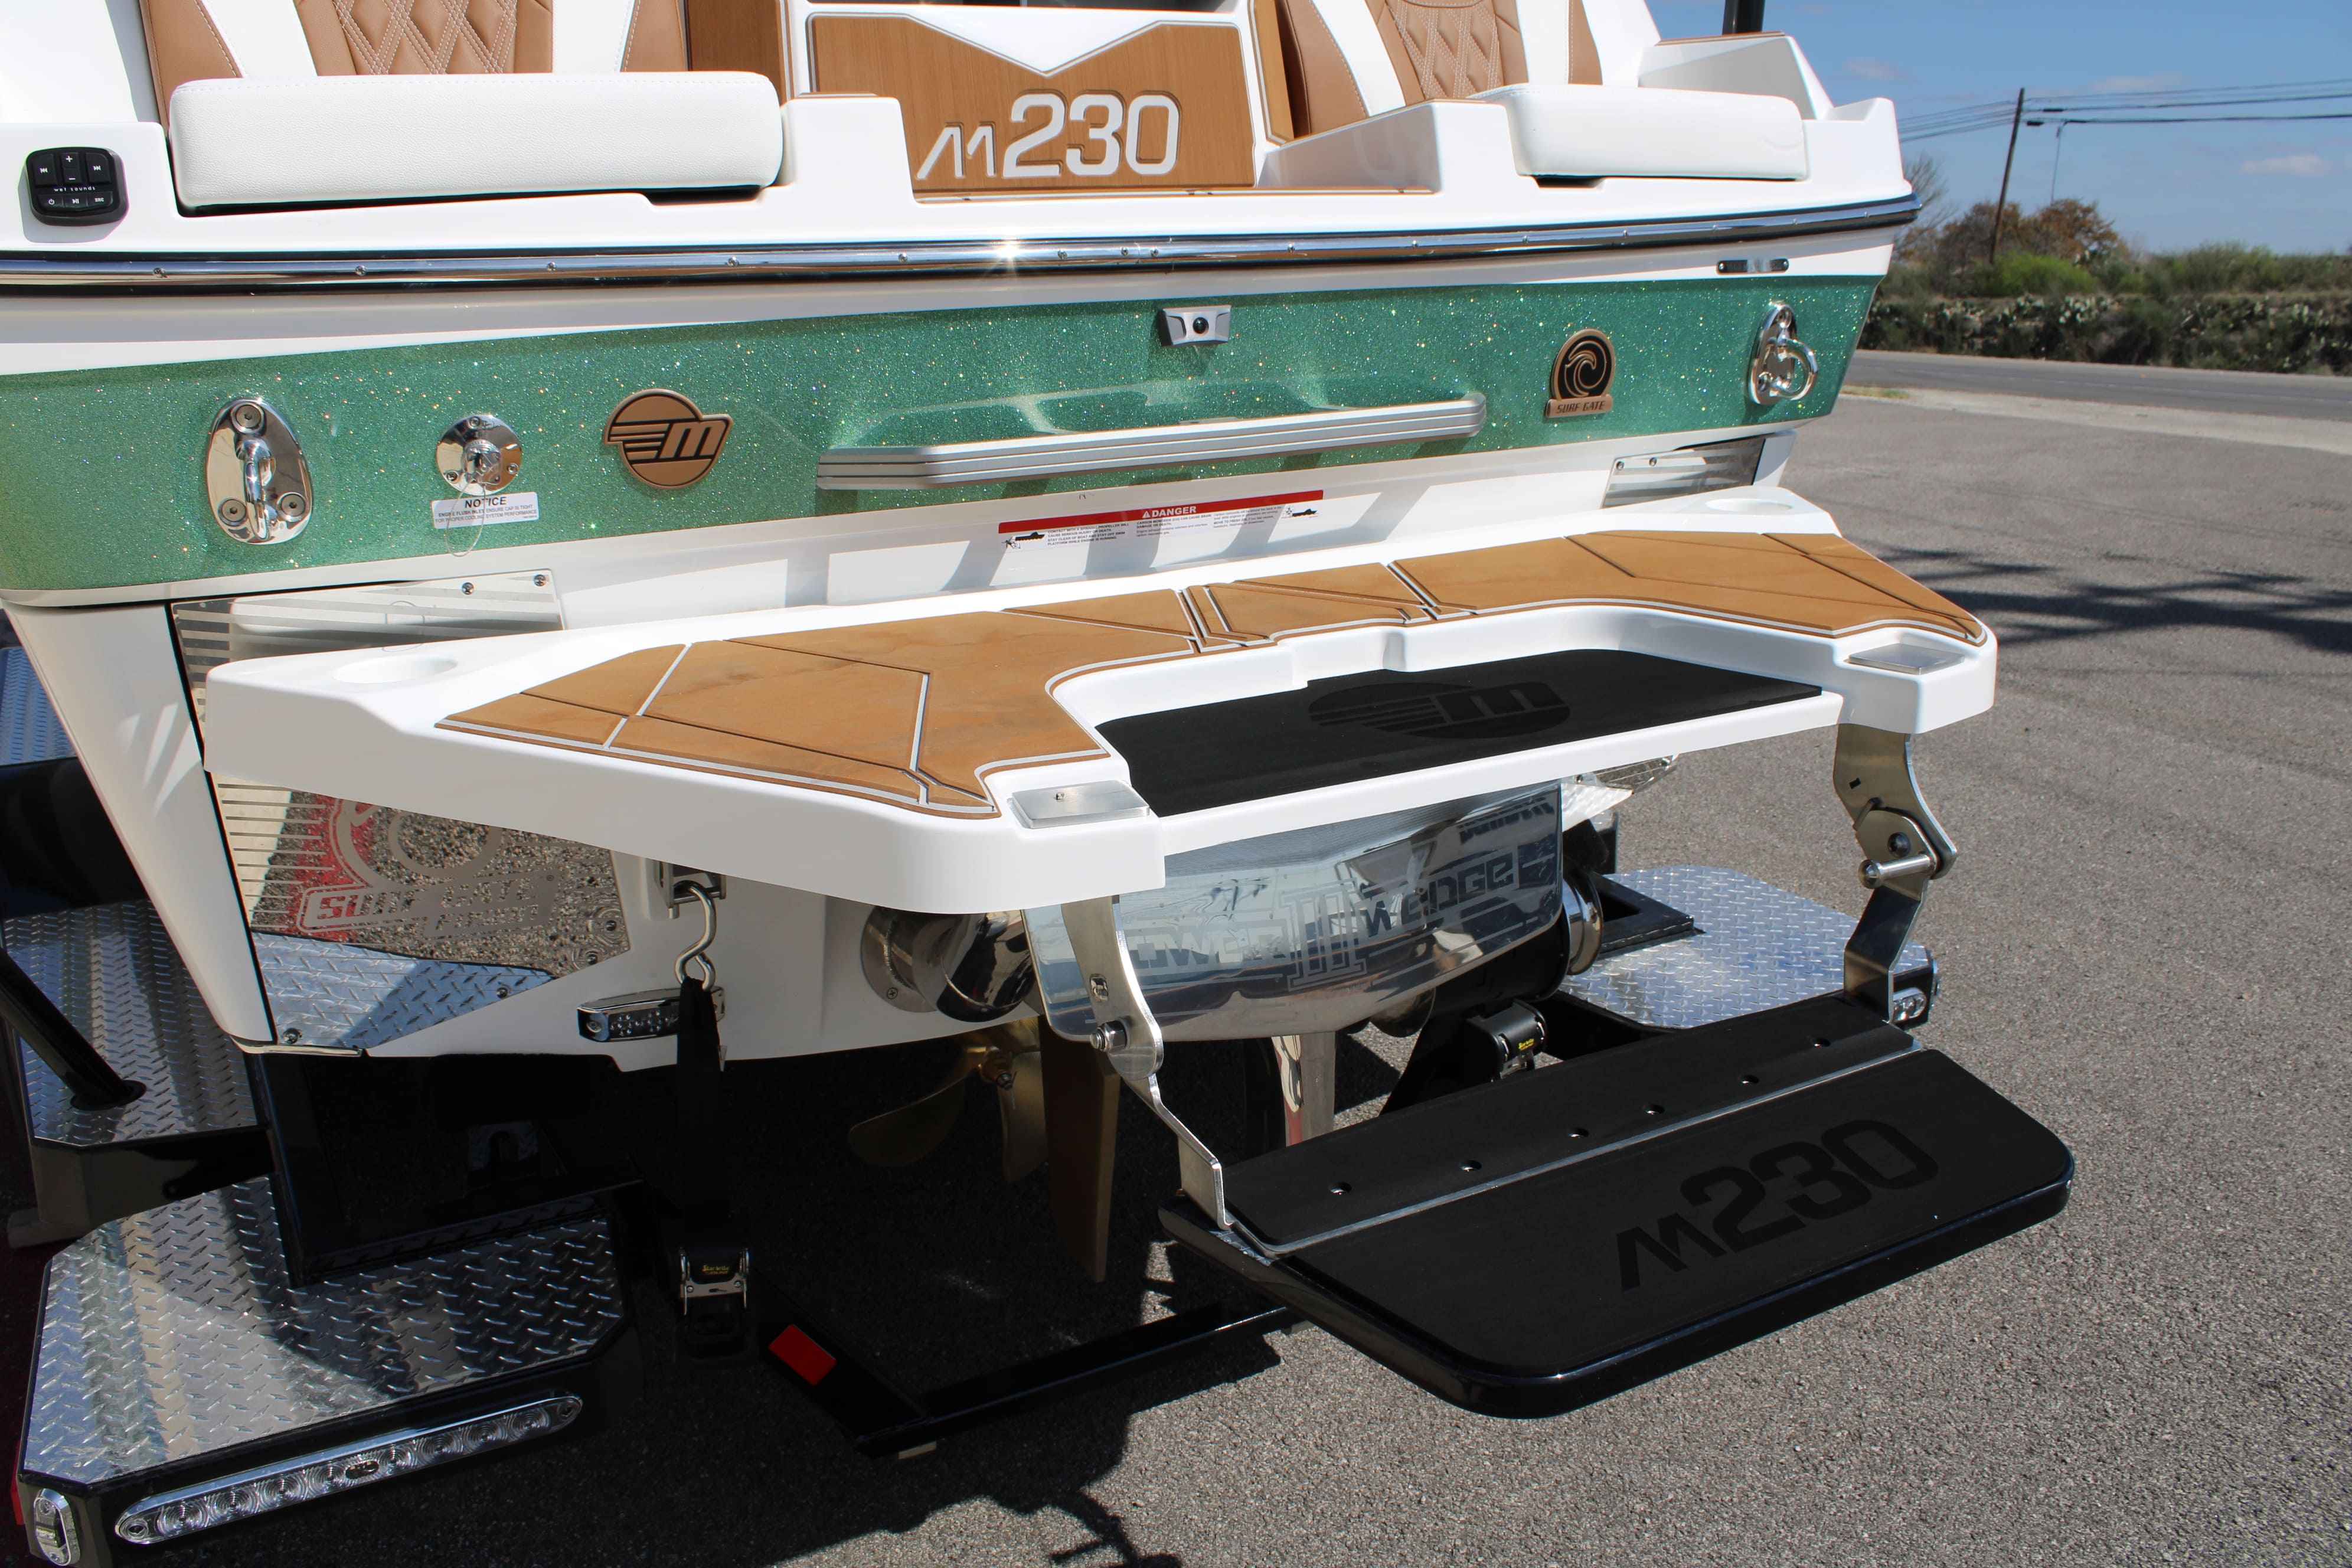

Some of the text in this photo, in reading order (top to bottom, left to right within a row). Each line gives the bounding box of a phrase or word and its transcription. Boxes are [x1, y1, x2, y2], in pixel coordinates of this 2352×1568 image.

[916, 90, 1181, 179] M230
[1557, 400, 1606, 414] SURF GATE
[465, 496, 507, 508] NOTICE
[1151, 506, 1197, 518] DANGER
[1616, 1121, 1939, 1292] M230
